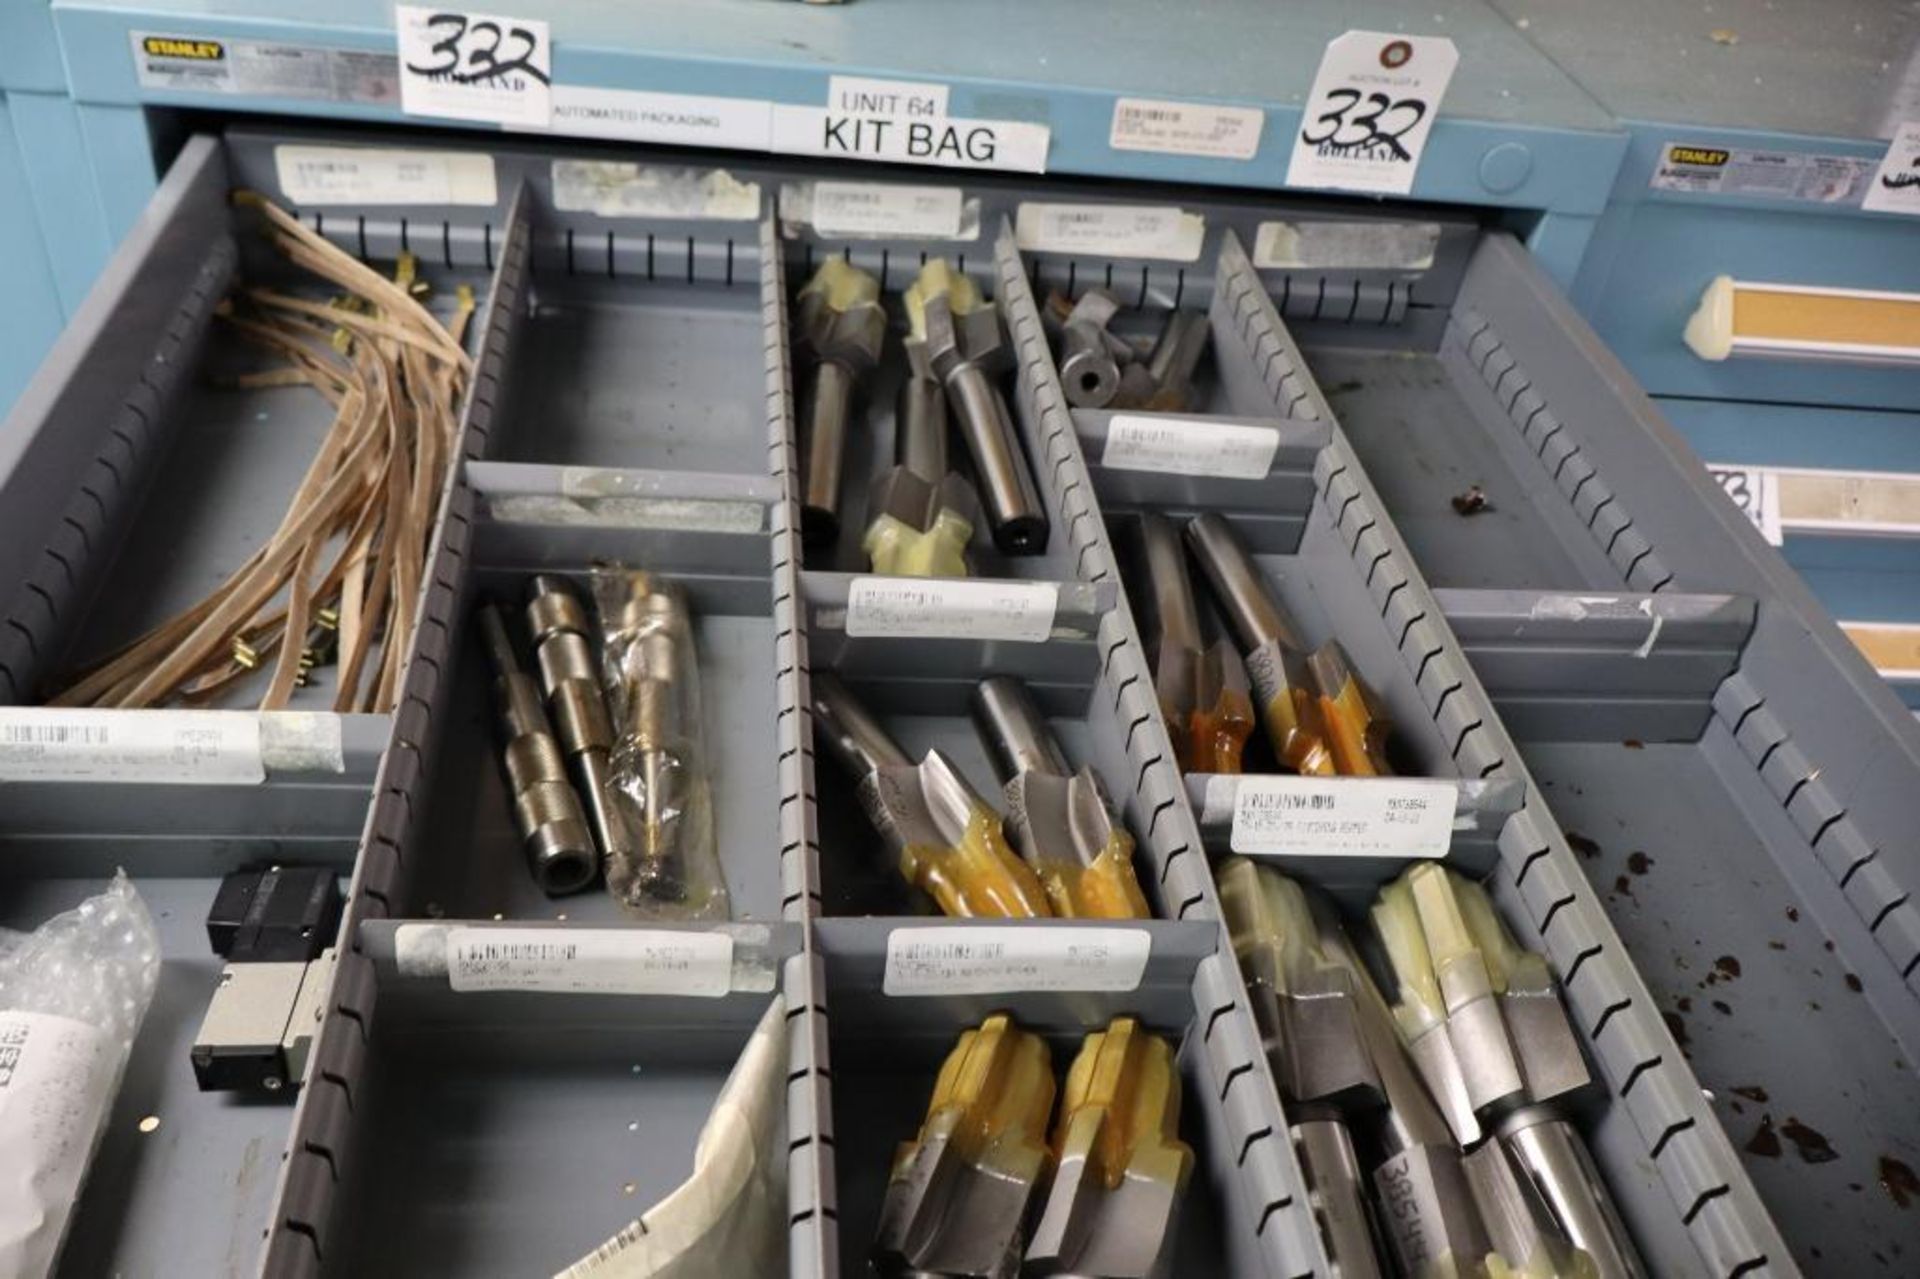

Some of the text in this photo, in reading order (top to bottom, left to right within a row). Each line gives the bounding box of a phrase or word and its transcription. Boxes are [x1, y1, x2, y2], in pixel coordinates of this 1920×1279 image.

[146, 40, 220, 58] STANLEY
[407, 14, 551, 88] 332
[842, 91, 936, 117] UNIT 64
[640, 112, 721, 129] PACKAGING
[1302, 88, 1426, 162] 332
[824, 116, 996, 162] KIT BAG
[1671, 149, 1727, 164] STANLEY
